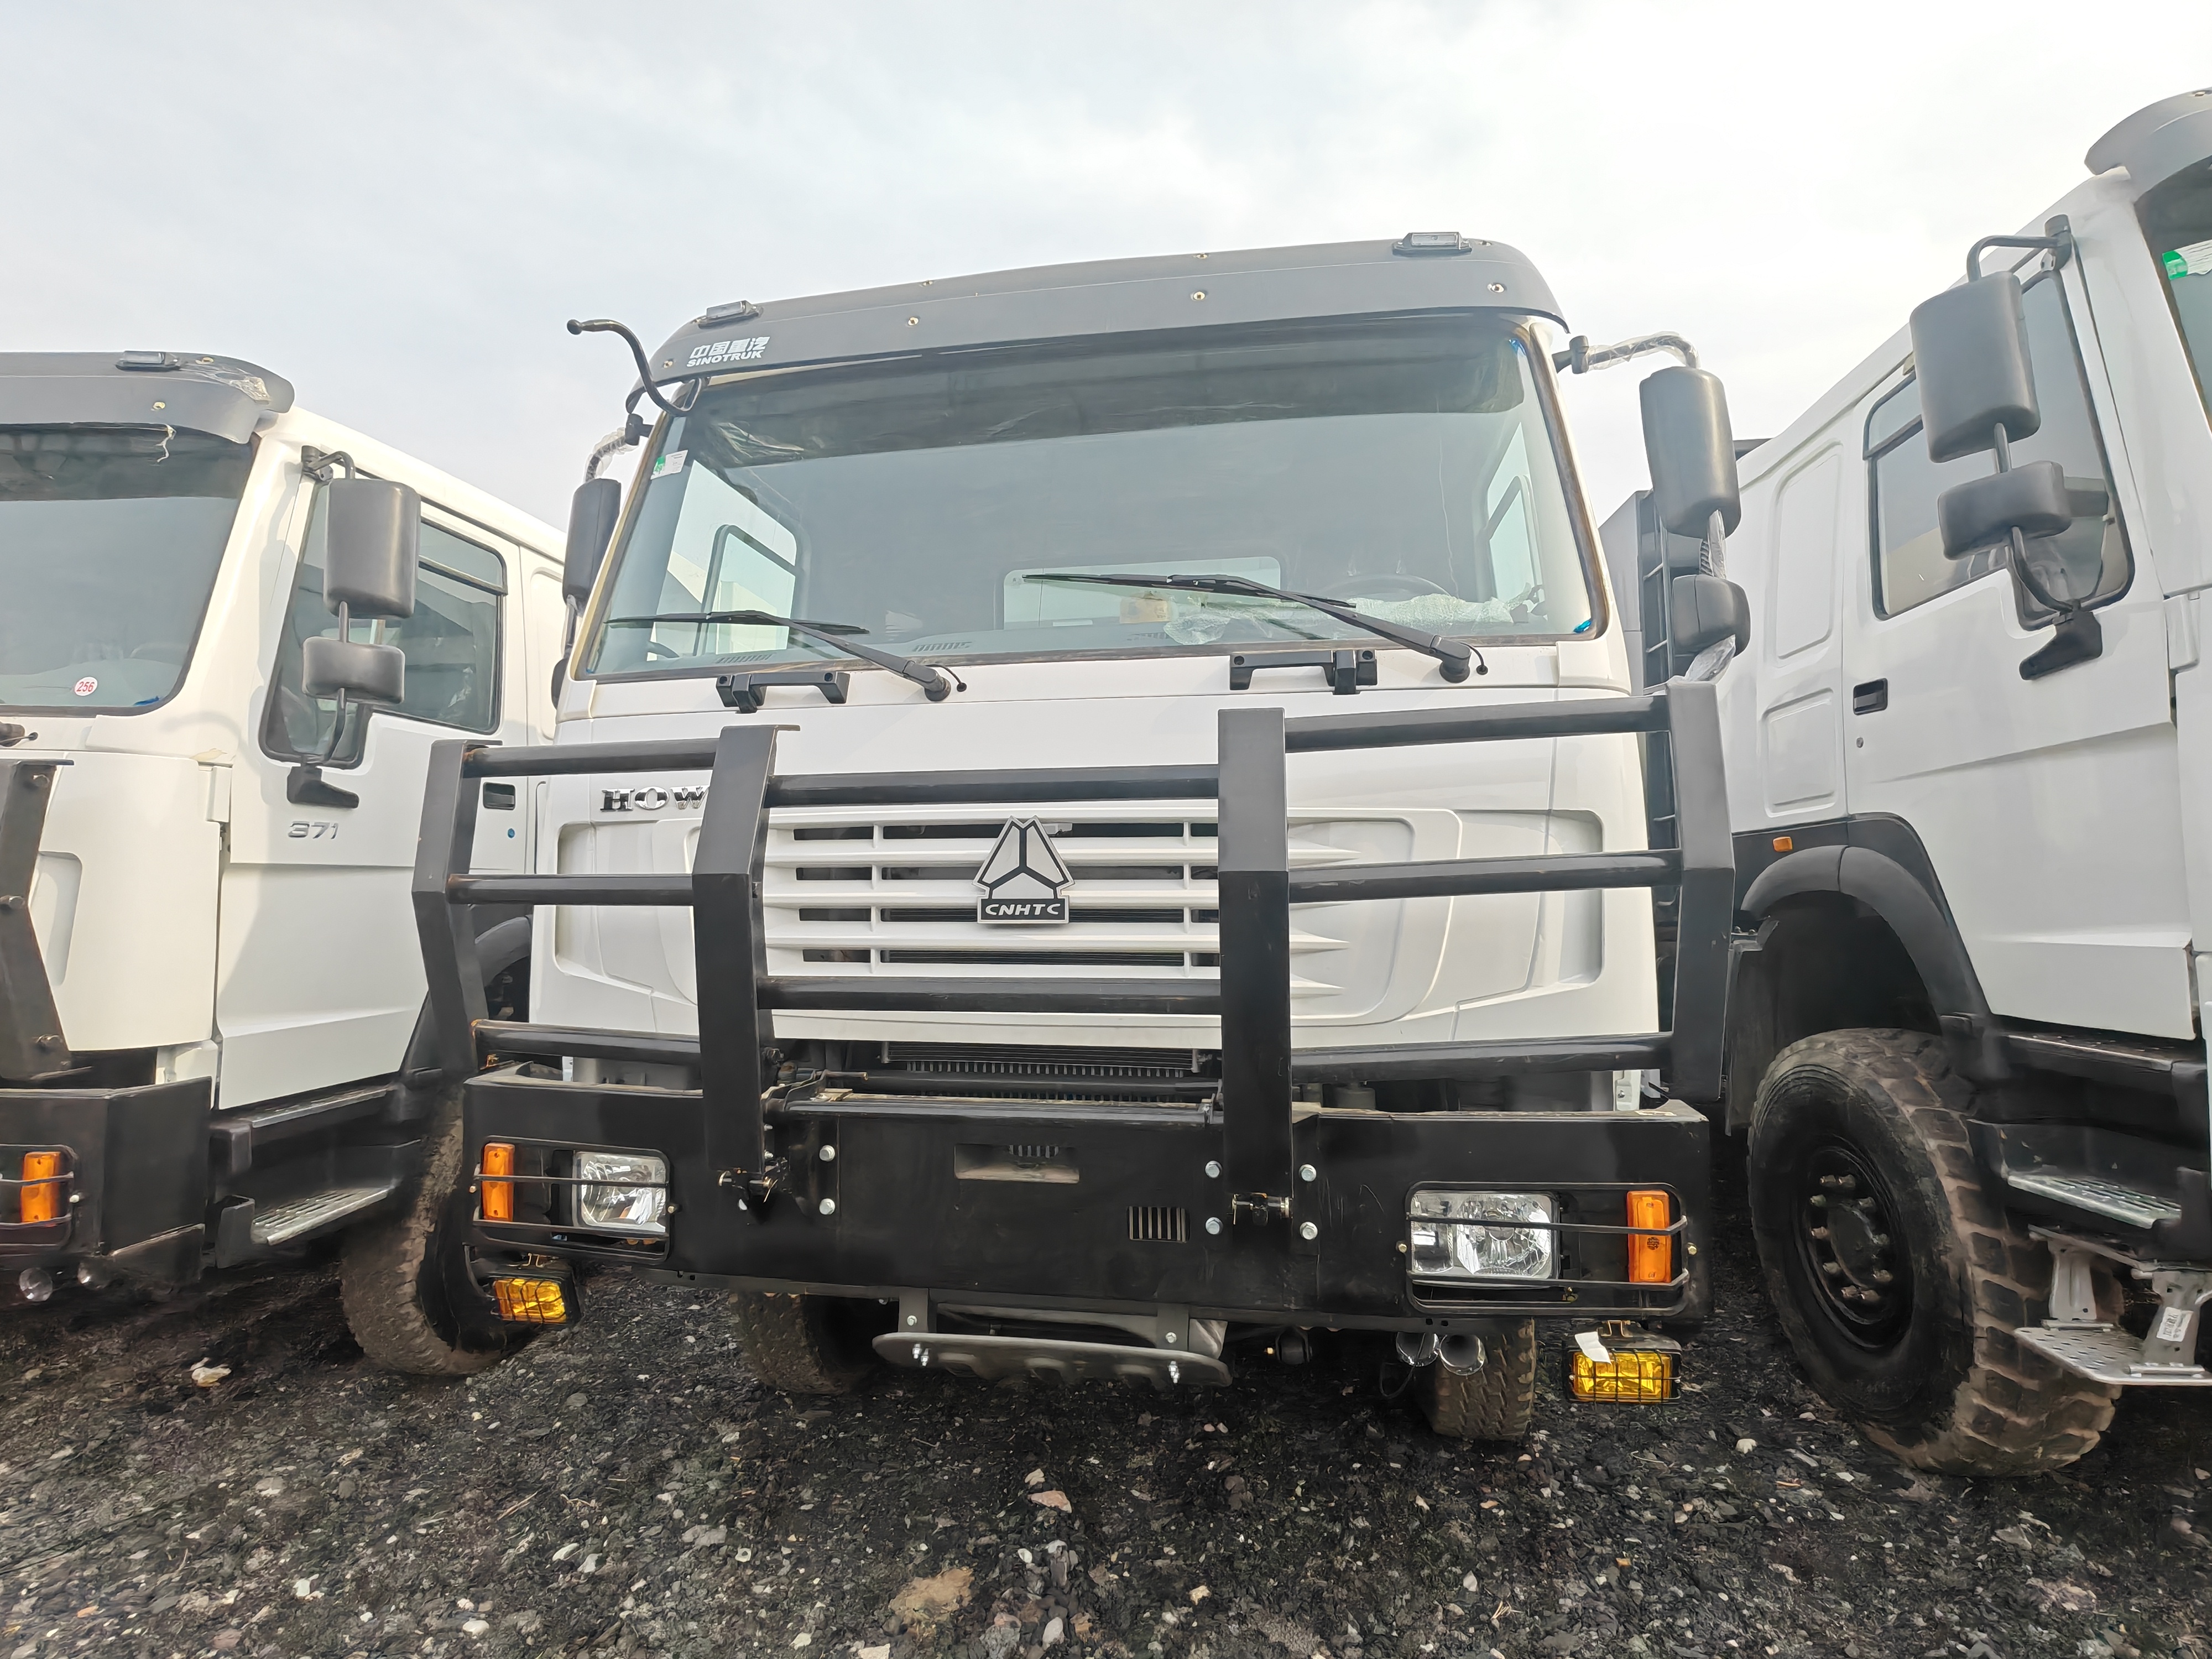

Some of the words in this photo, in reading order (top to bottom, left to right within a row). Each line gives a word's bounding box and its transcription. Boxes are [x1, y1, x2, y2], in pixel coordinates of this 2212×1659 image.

[690, 337, 770, 359] 中国重汽
[686, 350, 764, 367] SINOTRUK
[76, 681, 95, 692] 256
[288, 821, 338, 839] 371
[985, 904, 1061, 915] CNHTC
